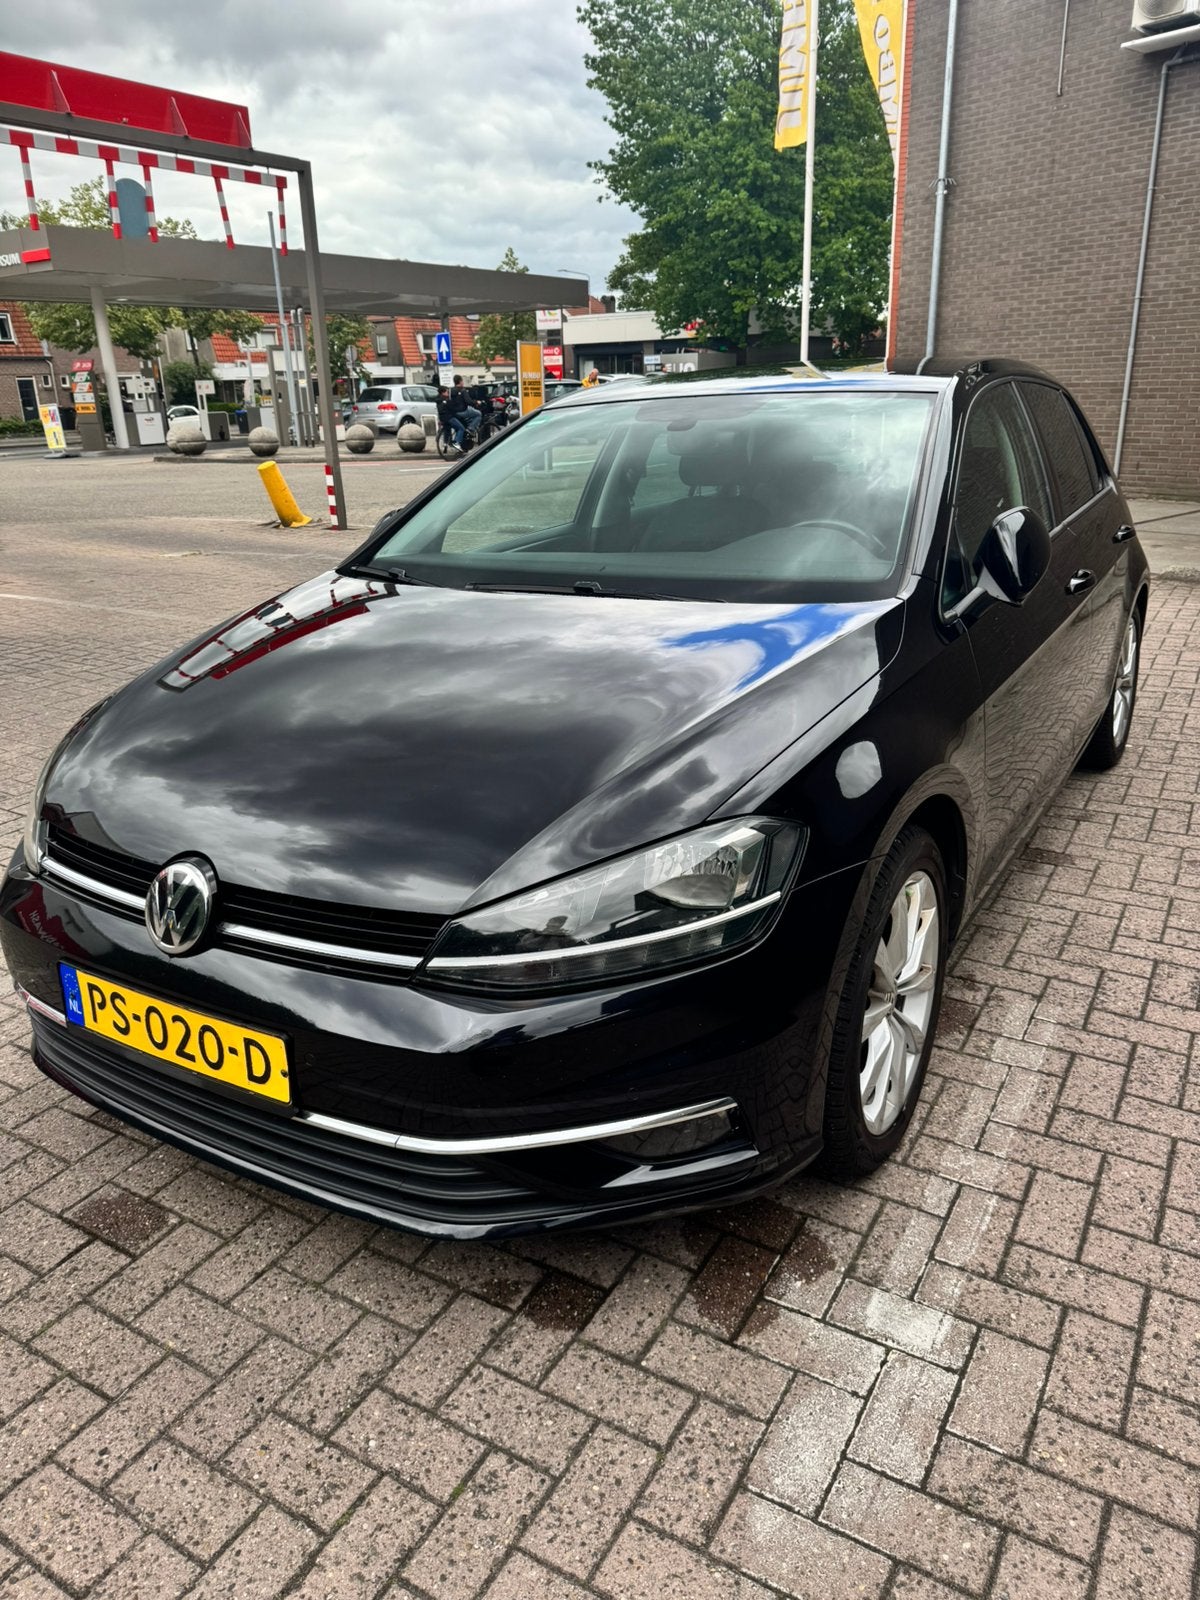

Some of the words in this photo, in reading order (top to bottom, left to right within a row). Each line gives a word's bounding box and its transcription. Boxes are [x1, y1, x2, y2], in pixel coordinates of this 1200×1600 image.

[874, 14, 899, 160] UMBO
[0, 252, 21, 266] SUM
[69, 998, 83, 1015] NL
[87, 982, 272, 1085] PS-020-D
